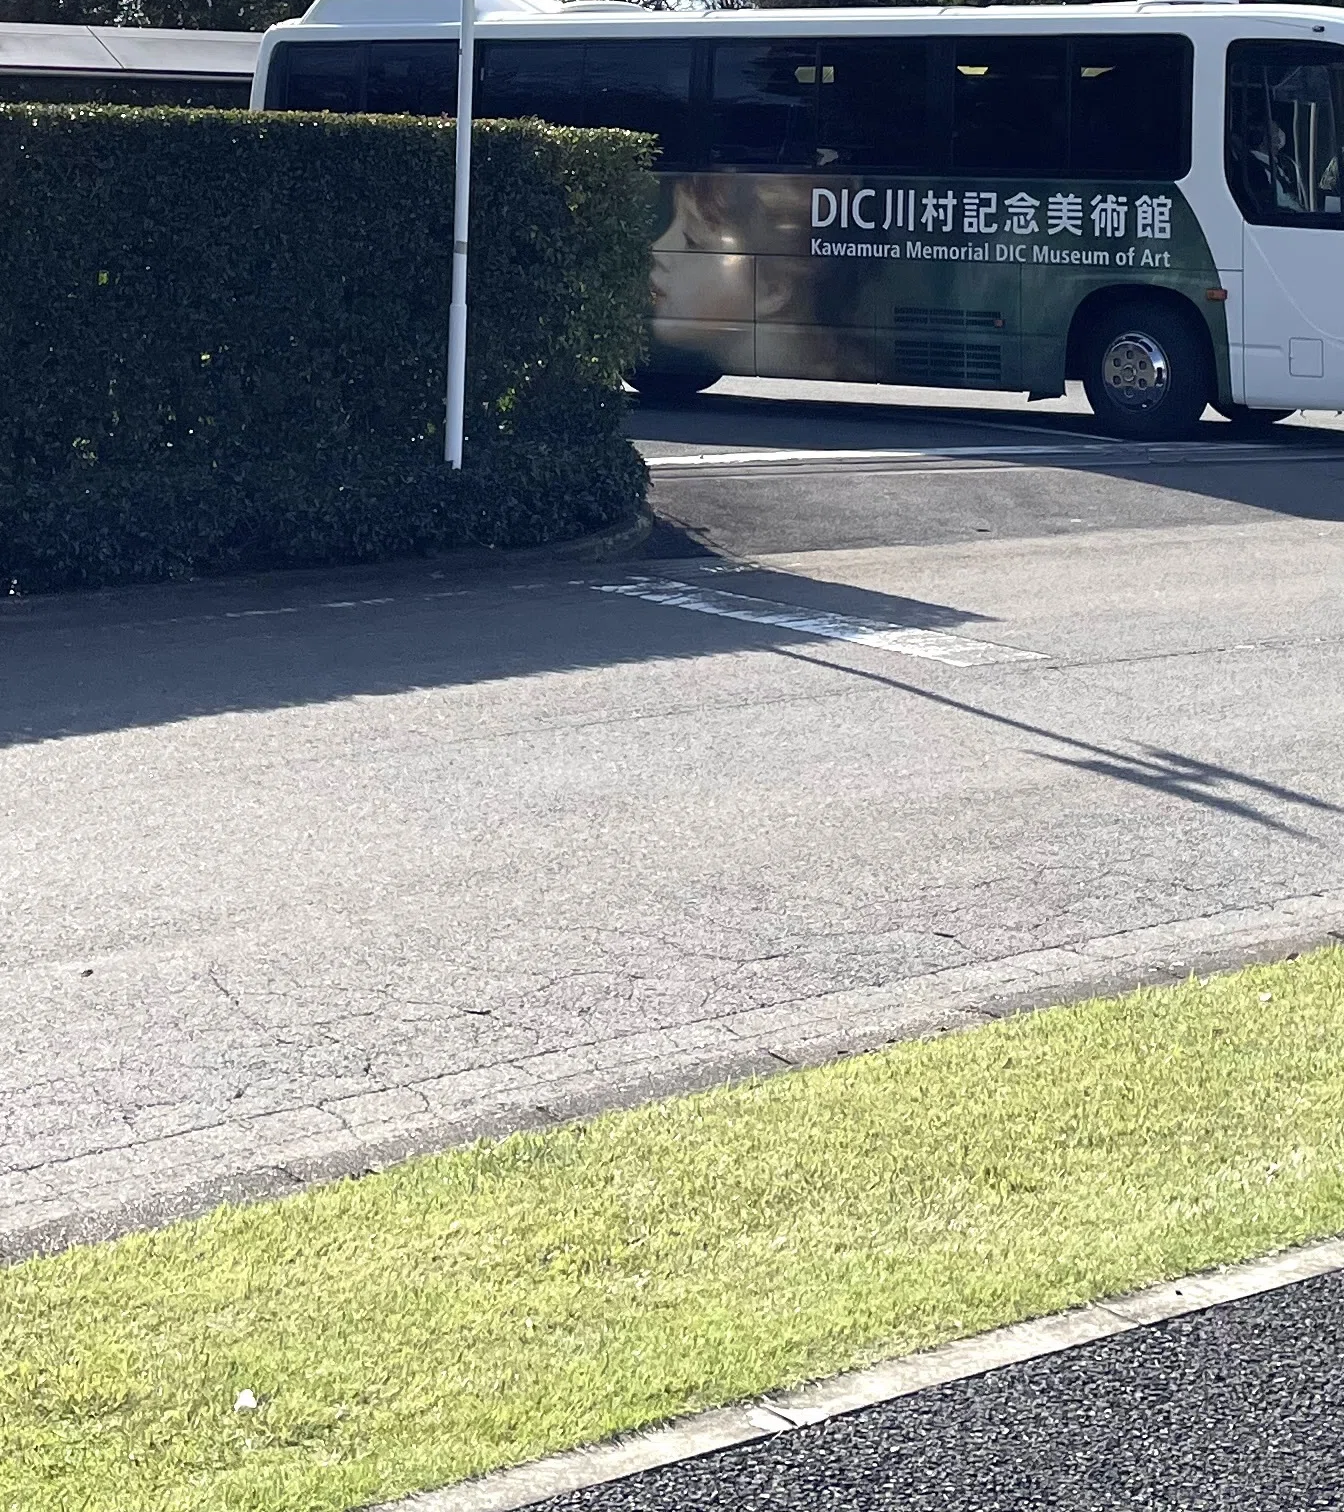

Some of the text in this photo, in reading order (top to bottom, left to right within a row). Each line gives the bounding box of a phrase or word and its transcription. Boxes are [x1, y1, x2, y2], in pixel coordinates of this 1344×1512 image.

[811, 188, 1172, 239] DIC川村記念美術館
[811, 238, 1172, 268] Kawamura Memorial DIC Museum of Art
